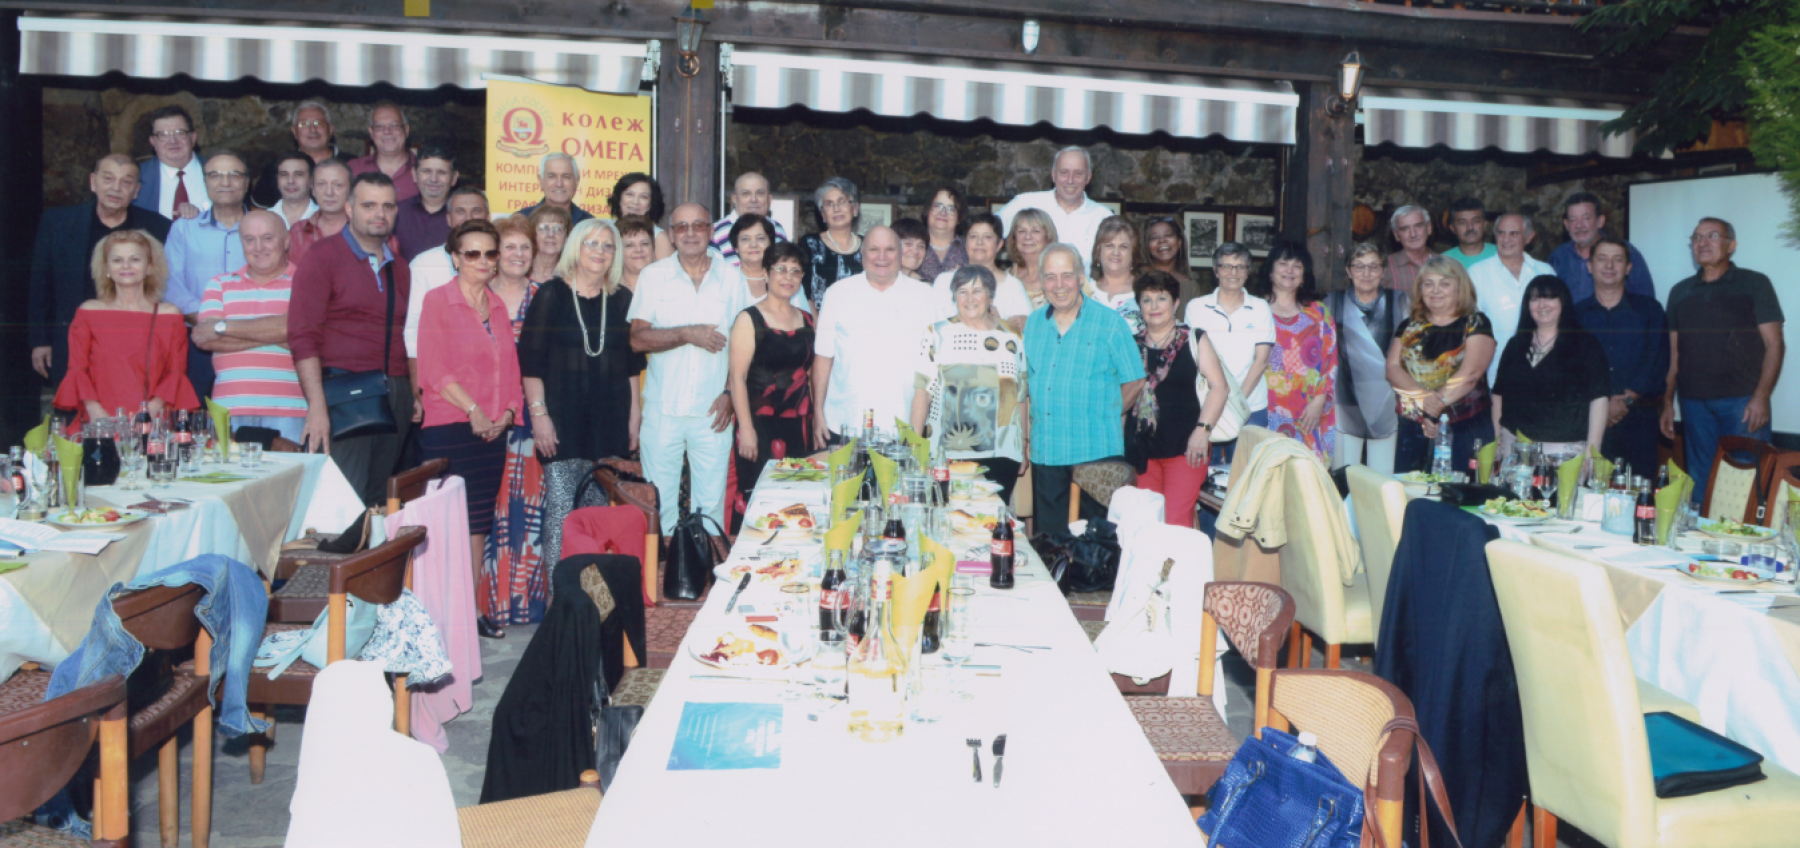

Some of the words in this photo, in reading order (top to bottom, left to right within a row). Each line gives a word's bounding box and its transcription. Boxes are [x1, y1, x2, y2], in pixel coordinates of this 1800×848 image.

[493, 96, 520, 124] OMEGA
[522, 95, 554, 128] COLLEGE
[562, 111, 645, 133] колеж
[561, 137, 645, 162] ОМЕГА
